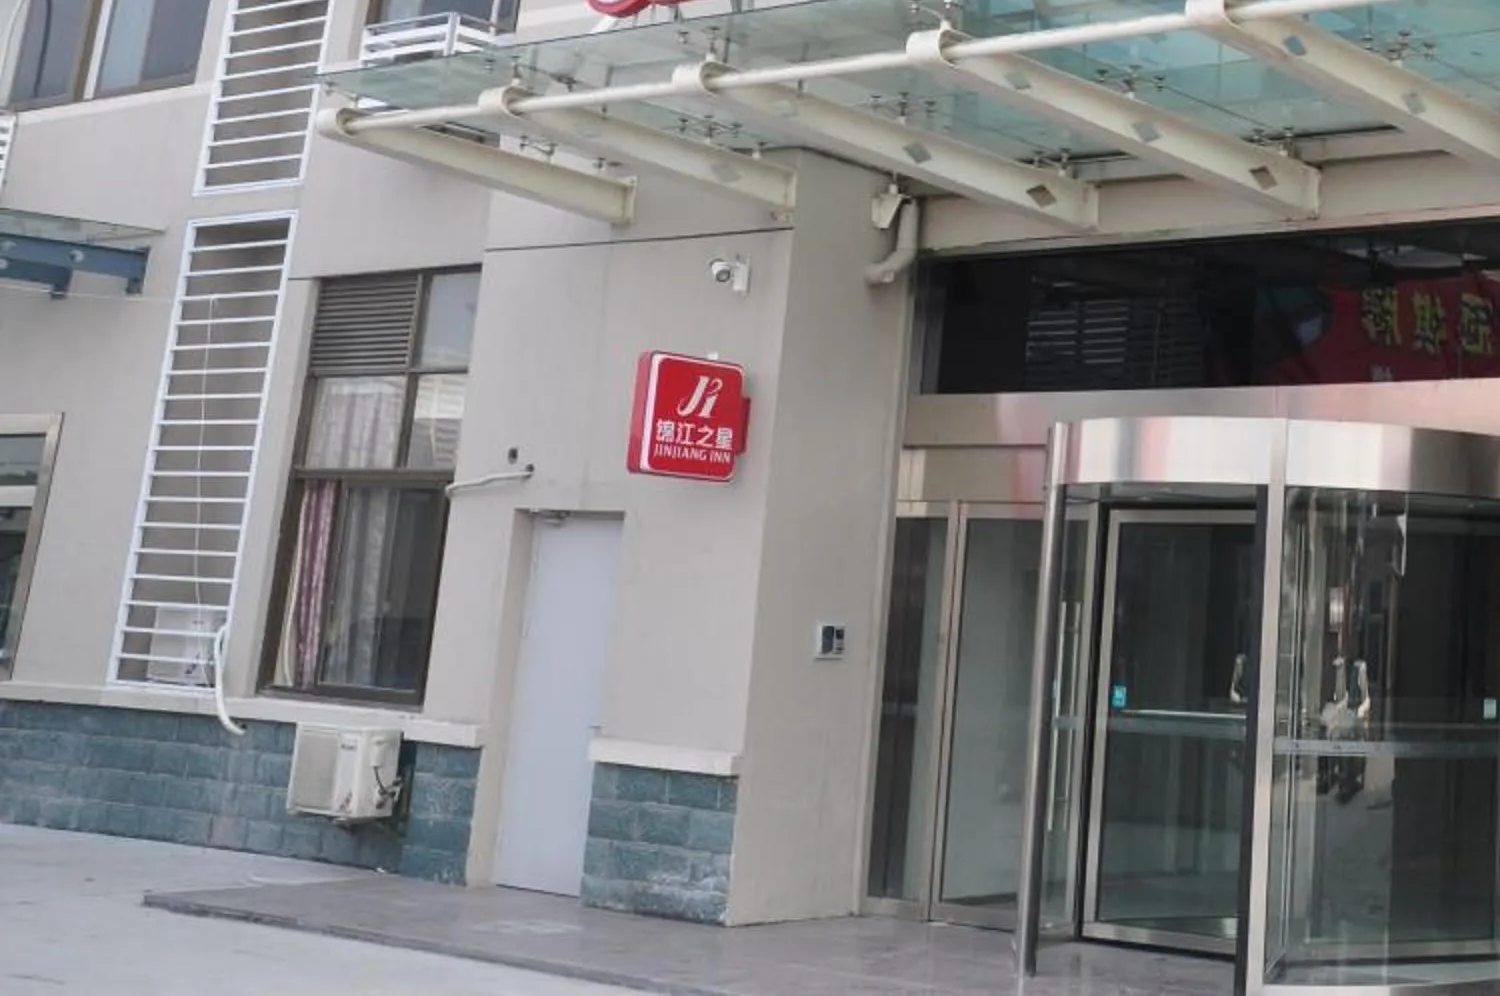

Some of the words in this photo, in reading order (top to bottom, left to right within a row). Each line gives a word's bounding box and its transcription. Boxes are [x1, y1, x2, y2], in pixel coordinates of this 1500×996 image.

[655, 419, 733, 451] 锦江之星
[654, 443, 707, 461] JINJIANG
[709, 449, 731, 464] INN
